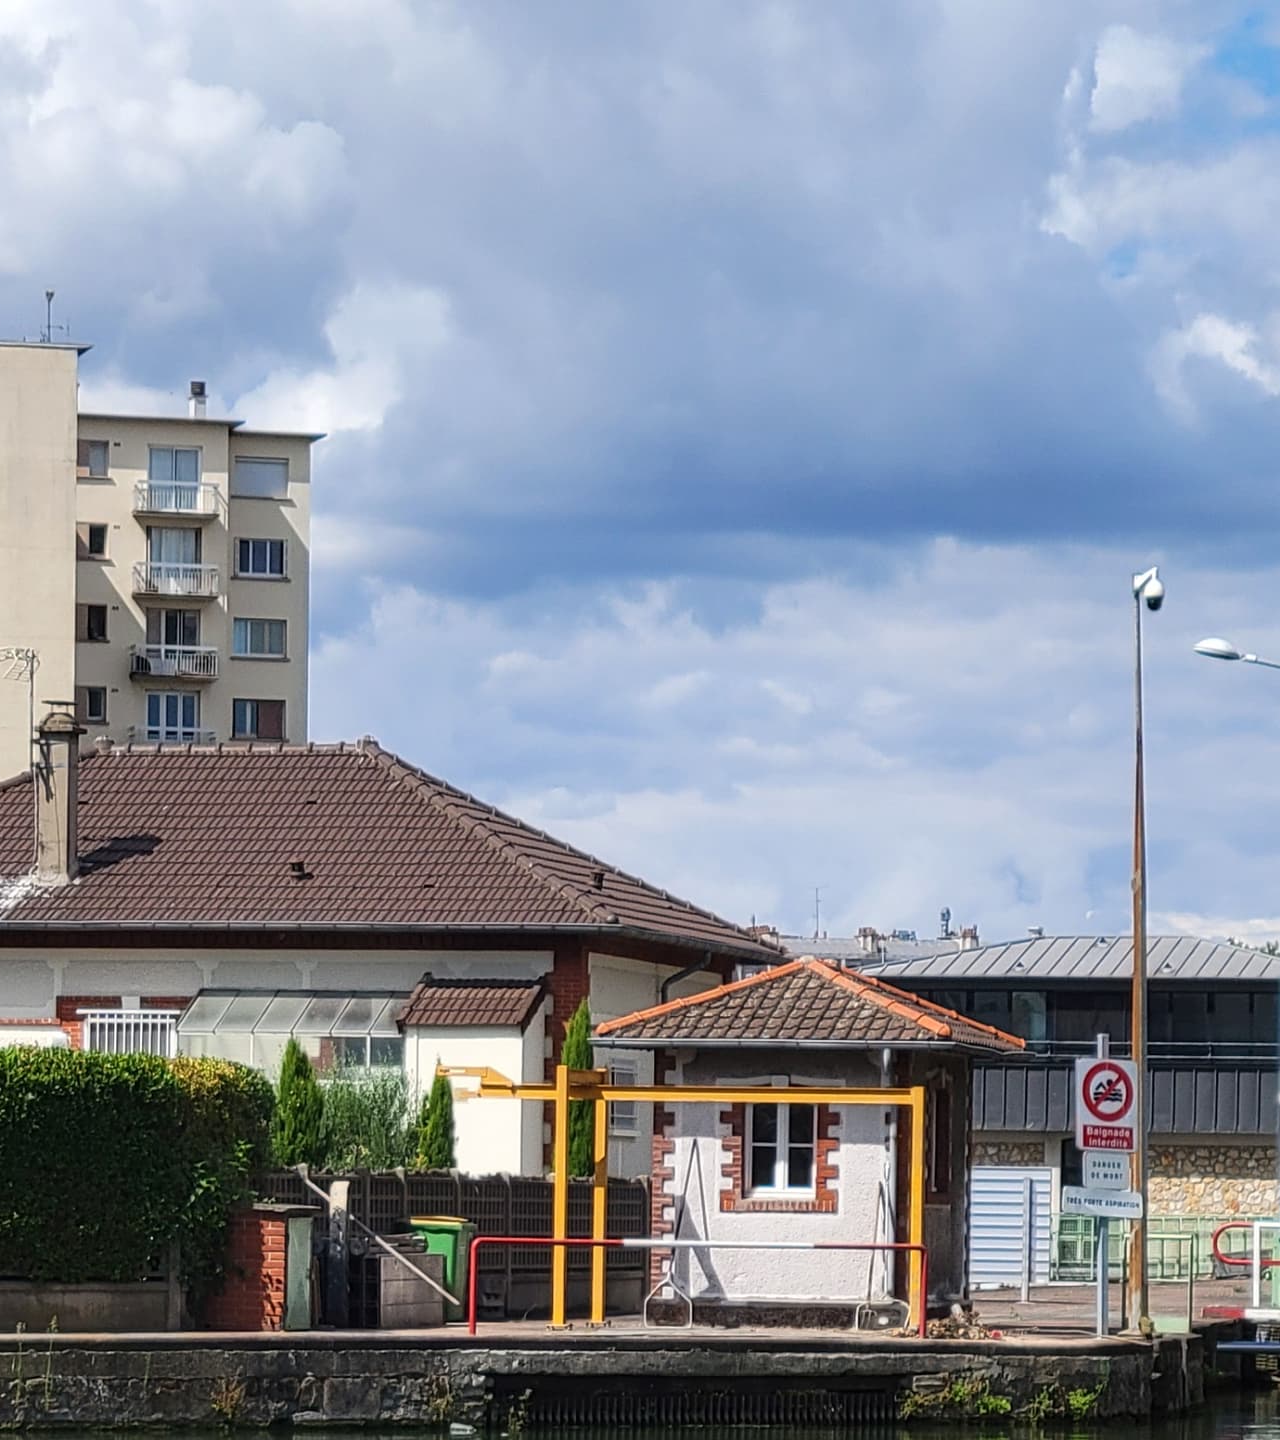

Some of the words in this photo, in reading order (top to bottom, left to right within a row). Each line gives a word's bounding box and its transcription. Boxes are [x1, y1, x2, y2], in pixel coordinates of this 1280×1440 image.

[1086, 1126, 1131, 1138] Baignade
[1088, 1137, 1129, 1148] Interdite
[1092, 1161, 1121, 1169] DANGER
[1091, 1171, 1100, 1179] DE
[1103, 1172, 1123, 1180] MORT
